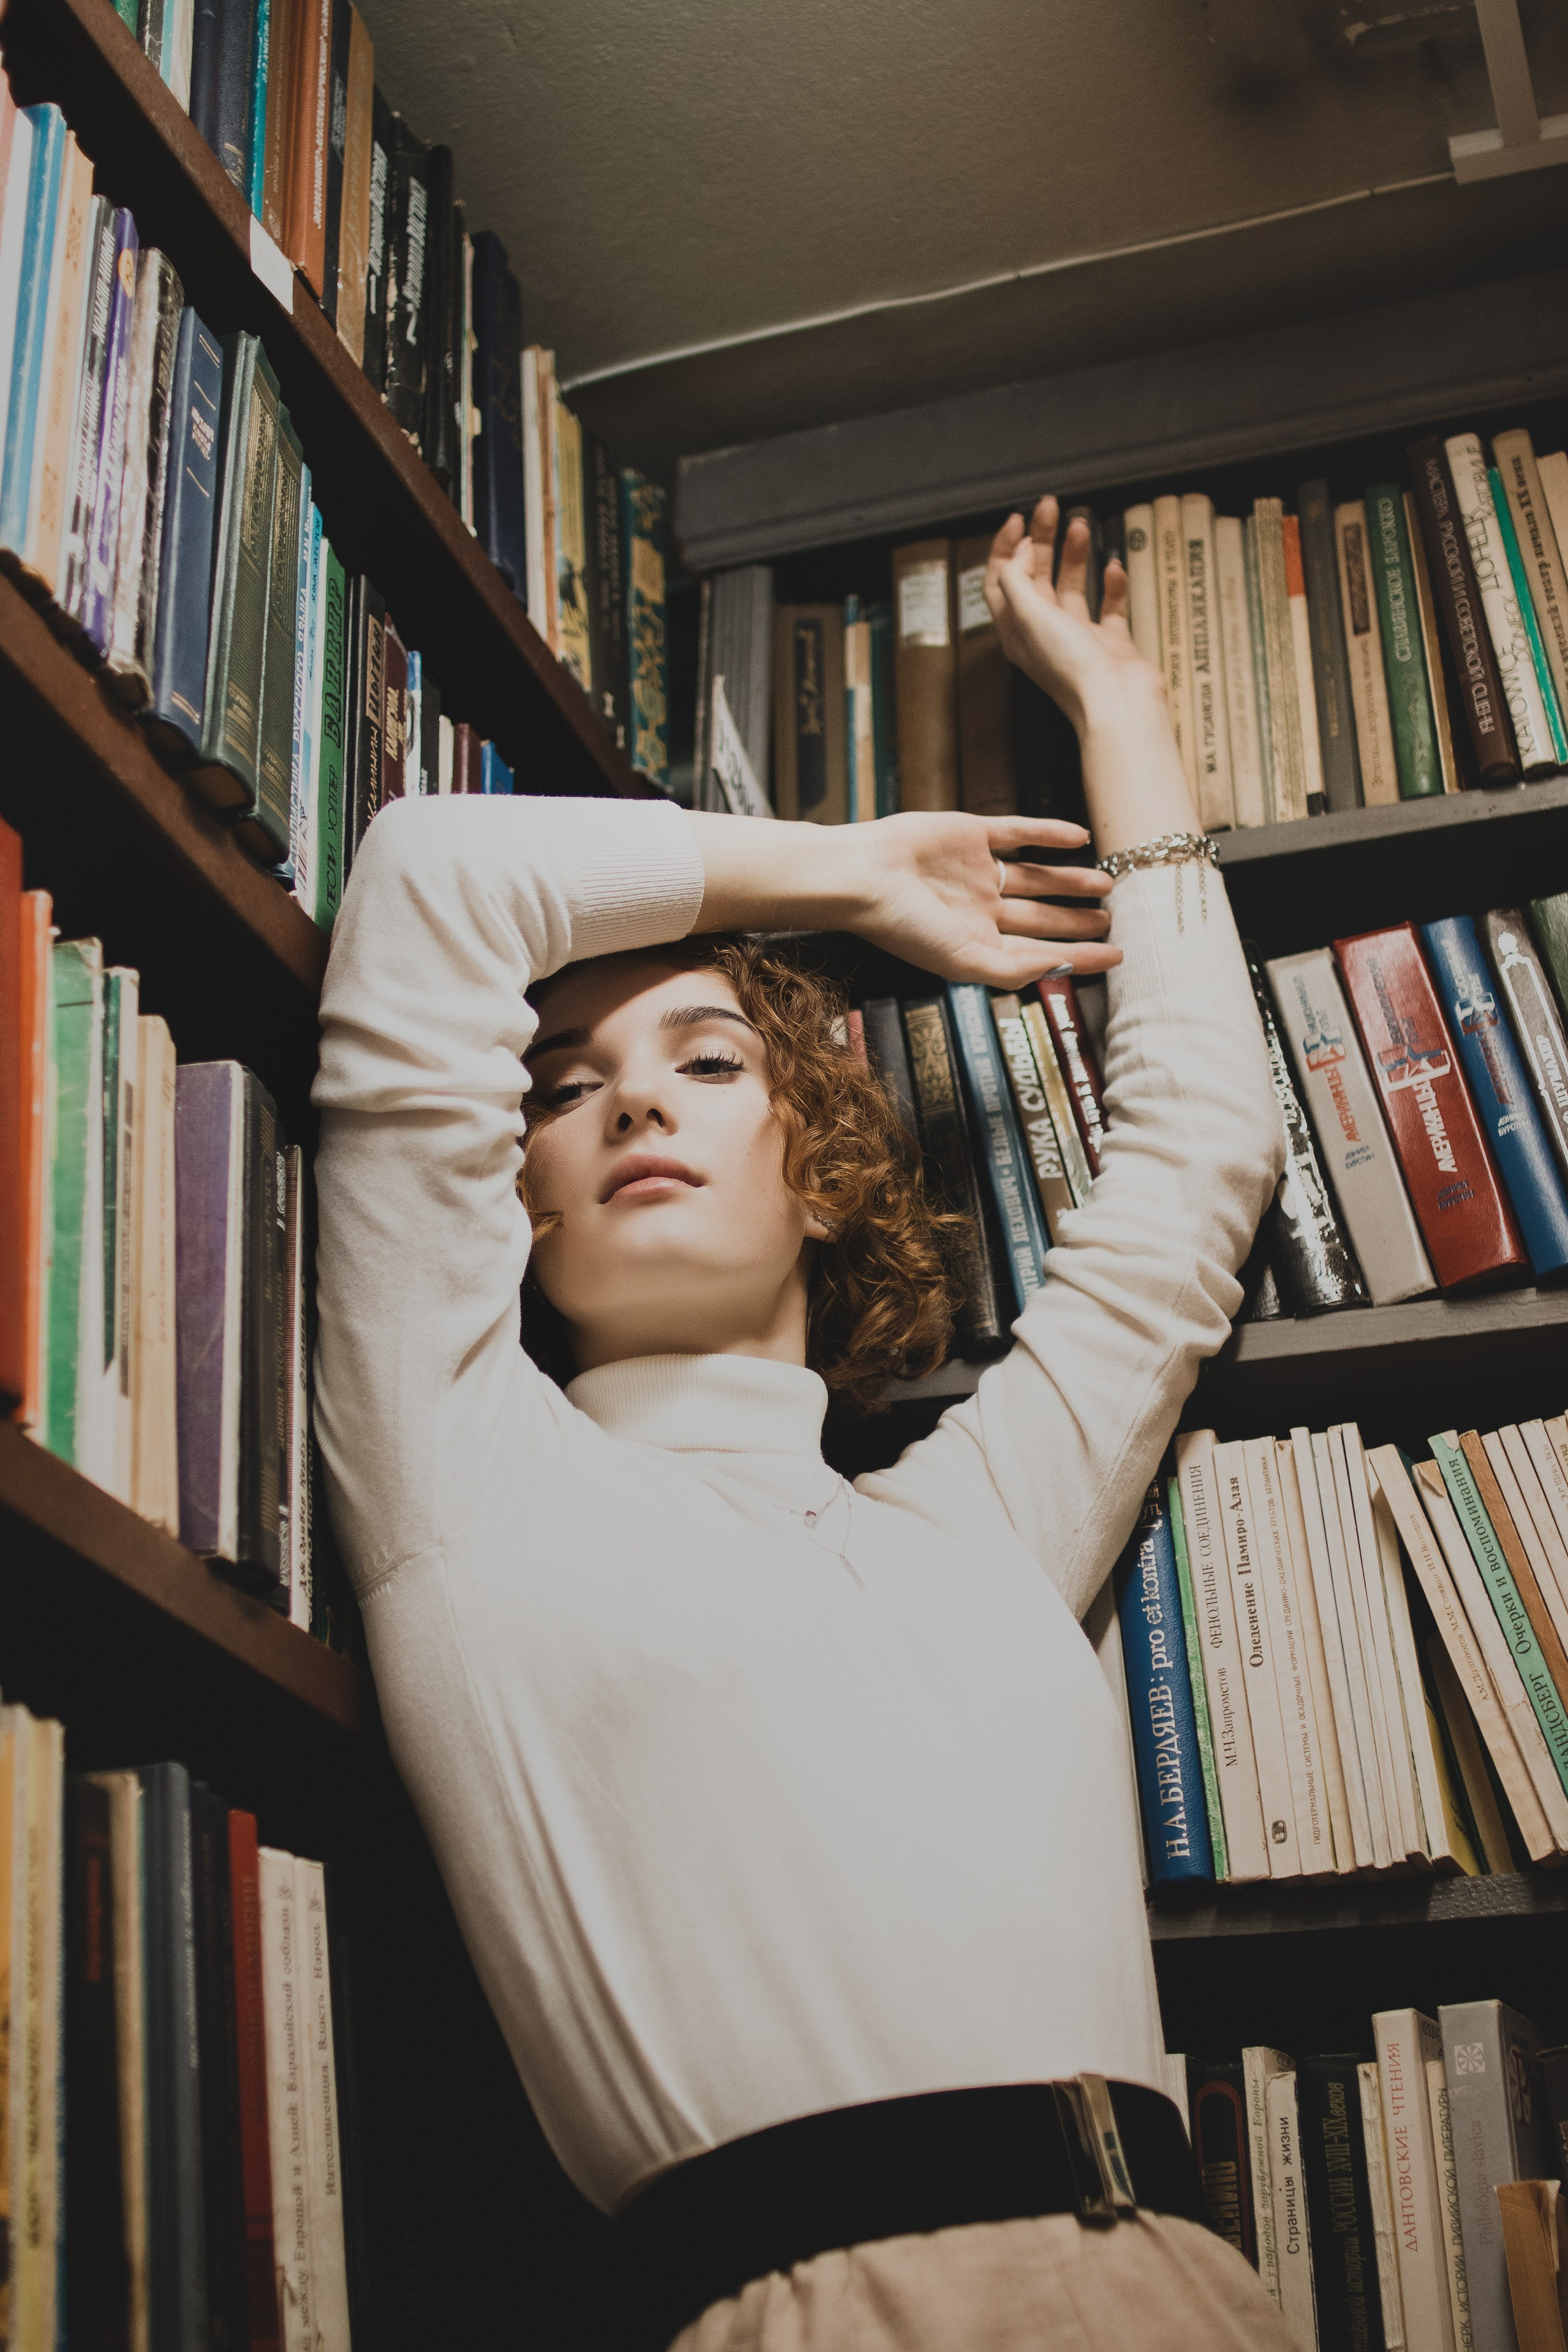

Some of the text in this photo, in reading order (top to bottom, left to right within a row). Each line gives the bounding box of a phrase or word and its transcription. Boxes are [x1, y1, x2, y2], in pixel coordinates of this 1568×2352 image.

[1425, 459, 1450, 518] МАСТЕРА
[1439, 521, 1465, 584] РУССКОЙ
[1454, 597, 1486, 682] СОВЕТСКОЙ
[1471, 682, 1496, 735] СЦЕНЫ
[1499, 644, 1538, 756] KATOWICE
[327, 764, 337, 835] УОЛЛЕР
[326, 841, 337, 912] ЛЕСЛИ
[973, 1057, 1002, 1111] ПРОТИВ
[998, 1017, 1064, 1179] РУКА СУДЬБЫ
[1322, 1065, 1362, 1142] АМЕРИКАНЦЫ
[986, 1116, 1012, 1166] БЕЛЫЕ
[1412, 1080, 1458, 1172] АМЕРИКАНЦЫ
[999, 1175, 1030, 1242] ЛЕХОВИЧ
[1260, 1456, 1273, 1495] АТЛАНТИКИ
[1267, 1498, 1278, 1528] ХРЕБТОВ
[1409, 1513, 1437, 1571] И.Н.Волощик
[1448, 1458, 1501, 1571] воспоминания
[1228, 1476, 1264, 1668] Оледенение Памиро-Алая
[1433, 1572, 1460, 1631] М.М.Сенявин
[1494, 1575, 1507, 1587] и
[1143, 1602, 1164, 1625] et
[1189, 1464, 1238, 1767] М.Н.Запрометов ФЕНОЛЬНЫЕ СОЕДИНЕНИЯ
[1501, 1592, 1532, 1654] Очерки
[1148, 1629, 1174, 1670] pro
[1286, 1629, 1298, 1672] ФОРМАЦИИ
[1292, 1675, 1306, 1721] ОСАДОЧНЫЕ
[1301, 1732, 1313, 1768] СИСТЕМЫ
[1204, 1772, 1222, 1841] Методическое
[1306, 1770, 1322, 1845] ГИДРОТЕРМАЛЬНЫЕ
[1386, 2043, 1419, 2253] ДАНТОВСКИЕ ЧТЕНИЯ
[1437, 2088, 1455, 2162] ЛИТЕРАТУРЫ
[1279, 2116, 1301, 2255] Страницы жизни
[1328, 2177, 1358, 2233] РОССИИ
[1444, 2169, 1463, 2246] ЛИВИЙСКОЙ
[1452, 2255, 1471, 2312] ИСТОРИИ
